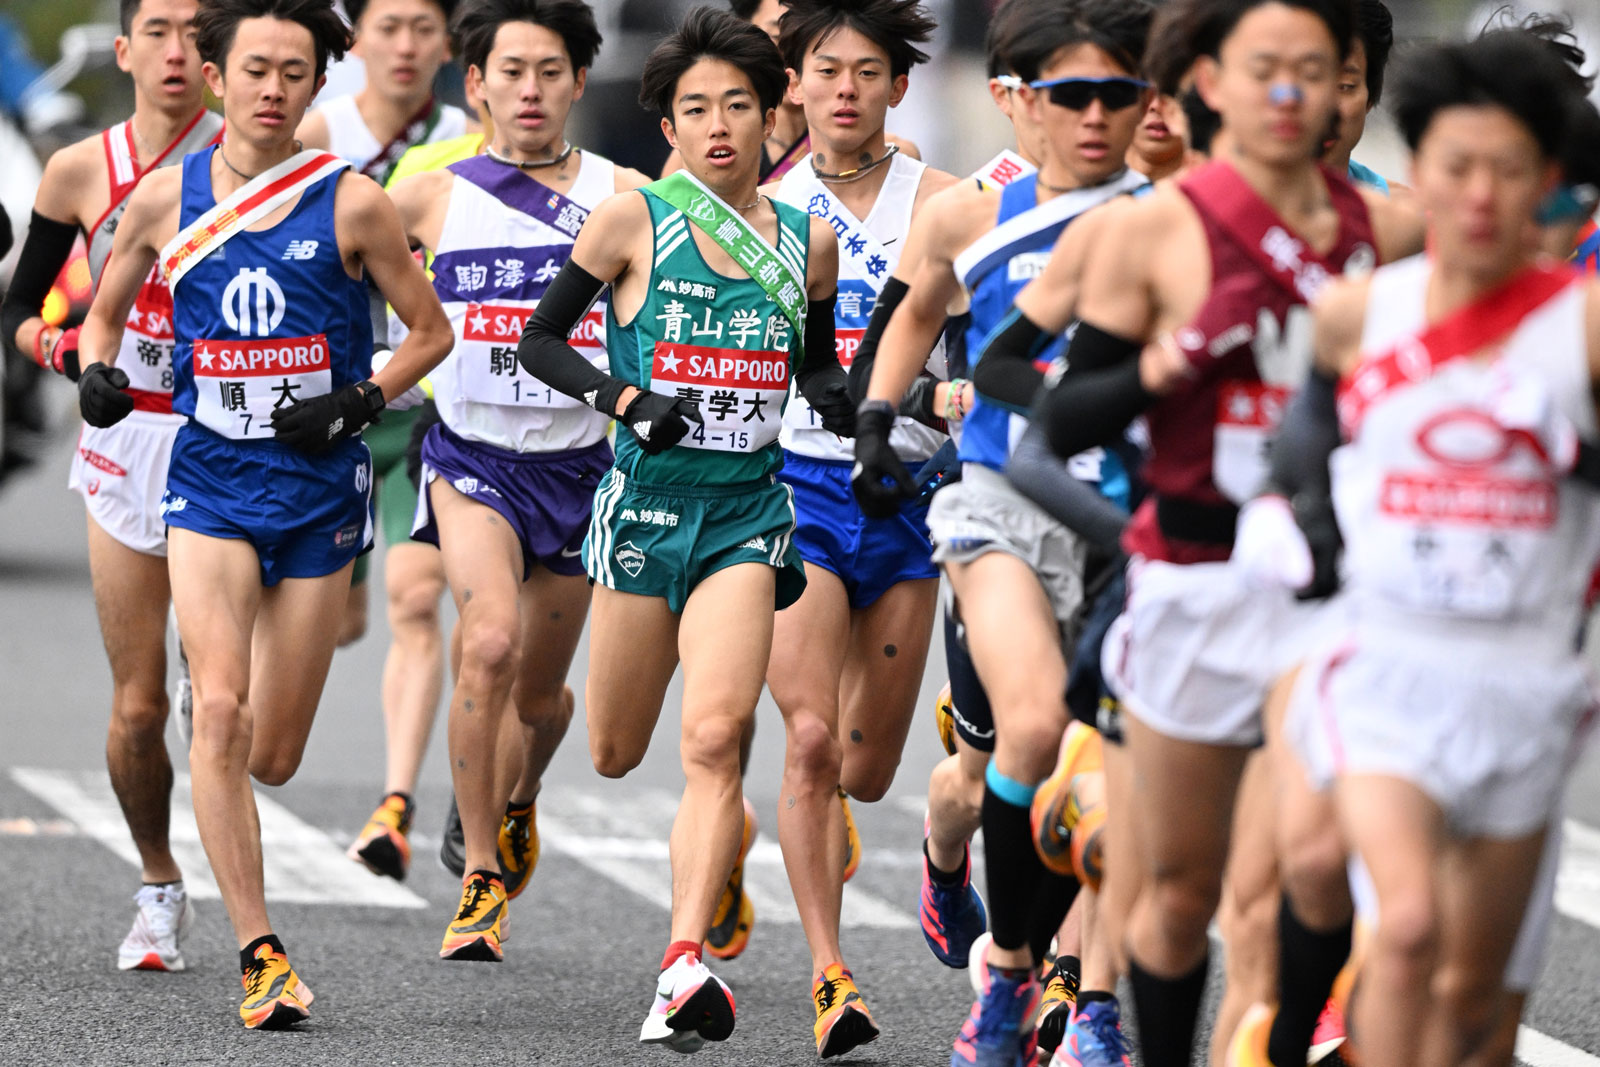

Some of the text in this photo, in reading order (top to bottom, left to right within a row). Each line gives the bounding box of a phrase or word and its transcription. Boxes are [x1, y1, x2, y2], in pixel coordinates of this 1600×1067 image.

[678, 280, 717, 301] 妙高市
[655, 299, 791, 353] 青山学院
[219, 343, 325, 371] SAPPORO
[687, 354, 787, 384] SAPPORO
[691, 420, 748, 449] 4-15
[639, 508, 679, 527] 妙高市
